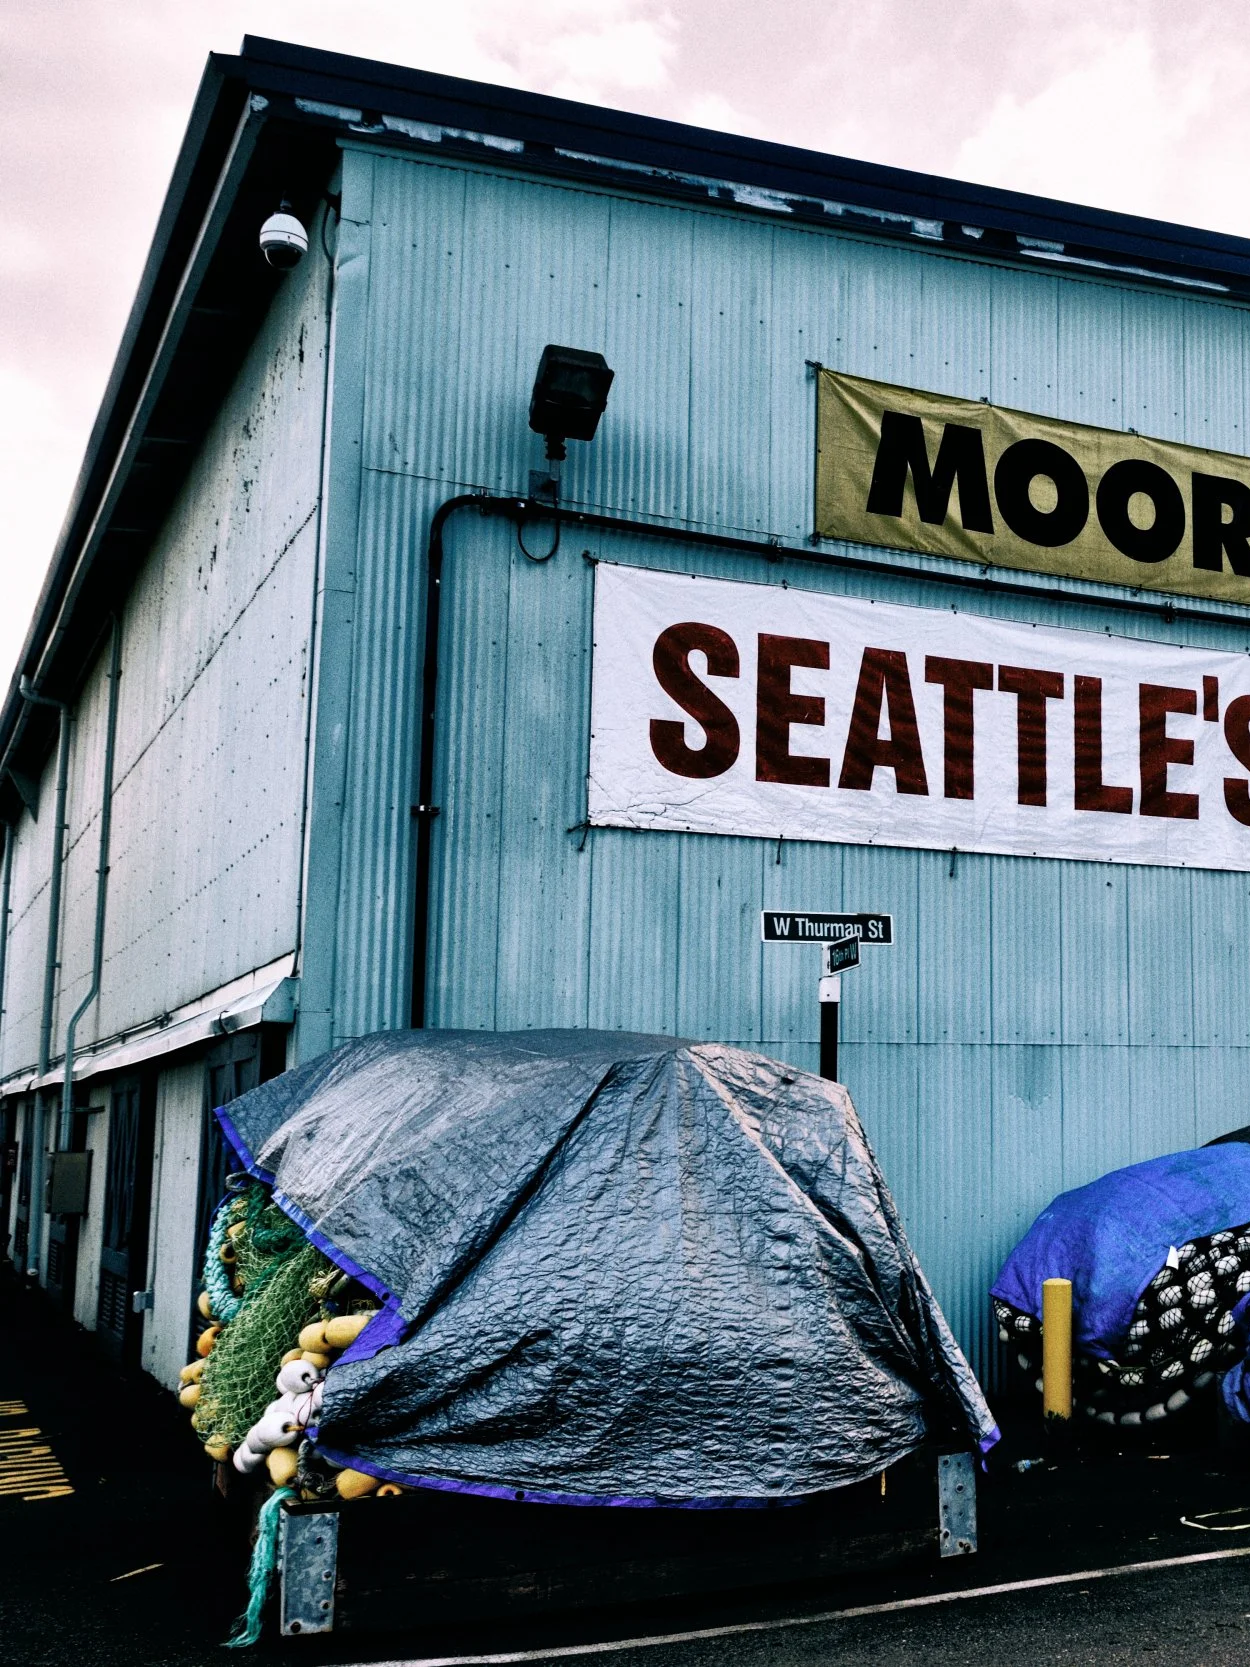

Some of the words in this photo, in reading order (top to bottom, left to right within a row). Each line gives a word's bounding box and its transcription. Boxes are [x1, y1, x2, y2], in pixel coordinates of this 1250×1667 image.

[773, 917, 790, 936] W
[795, 917, 863, 938] Thurman
[868, 919, 884, 939] St
[849, 942, 858, 961] W
